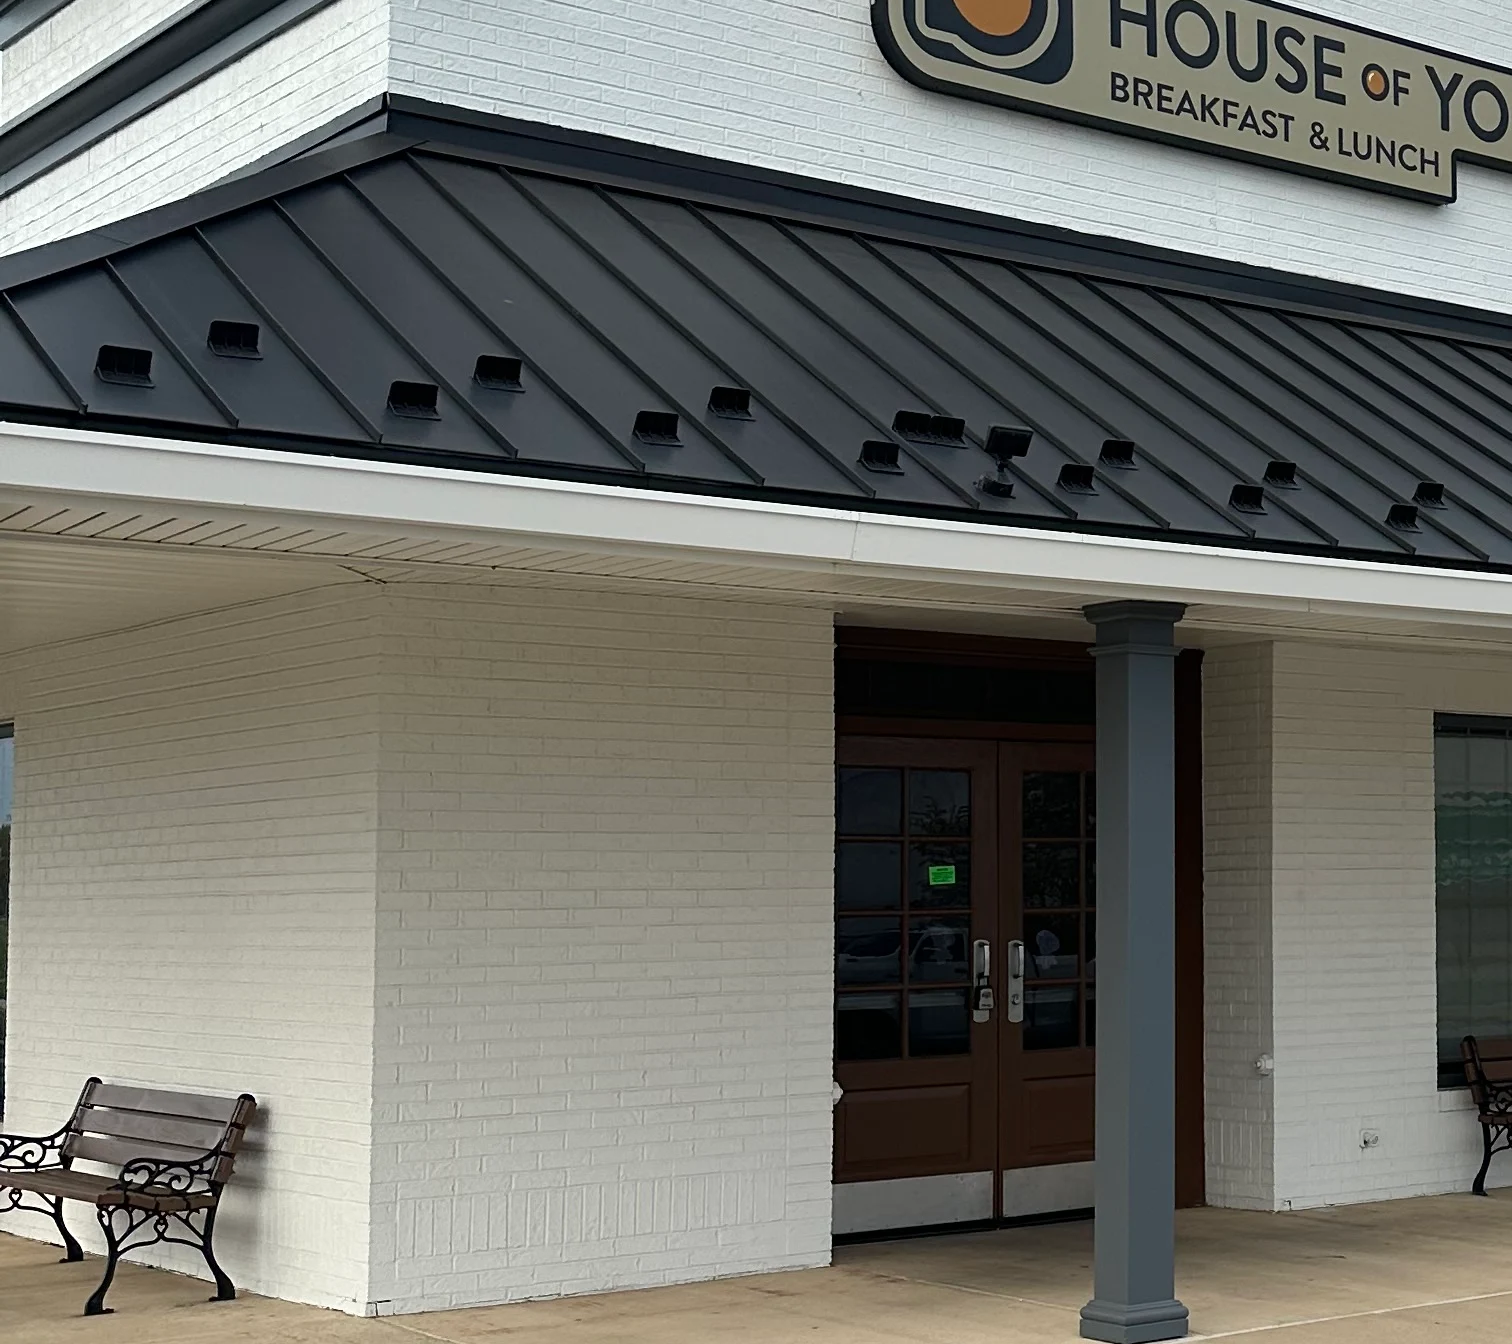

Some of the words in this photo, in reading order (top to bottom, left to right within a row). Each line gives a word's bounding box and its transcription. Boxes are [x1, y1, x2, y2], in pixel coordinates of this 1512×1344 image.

[1361, 63, 1411, 106] OF
[1110, 71, 1295, 142] BREAKFAST
[1309, 121, 1330, 152] &
[1338, 127, 1440, 177] LUNCH
